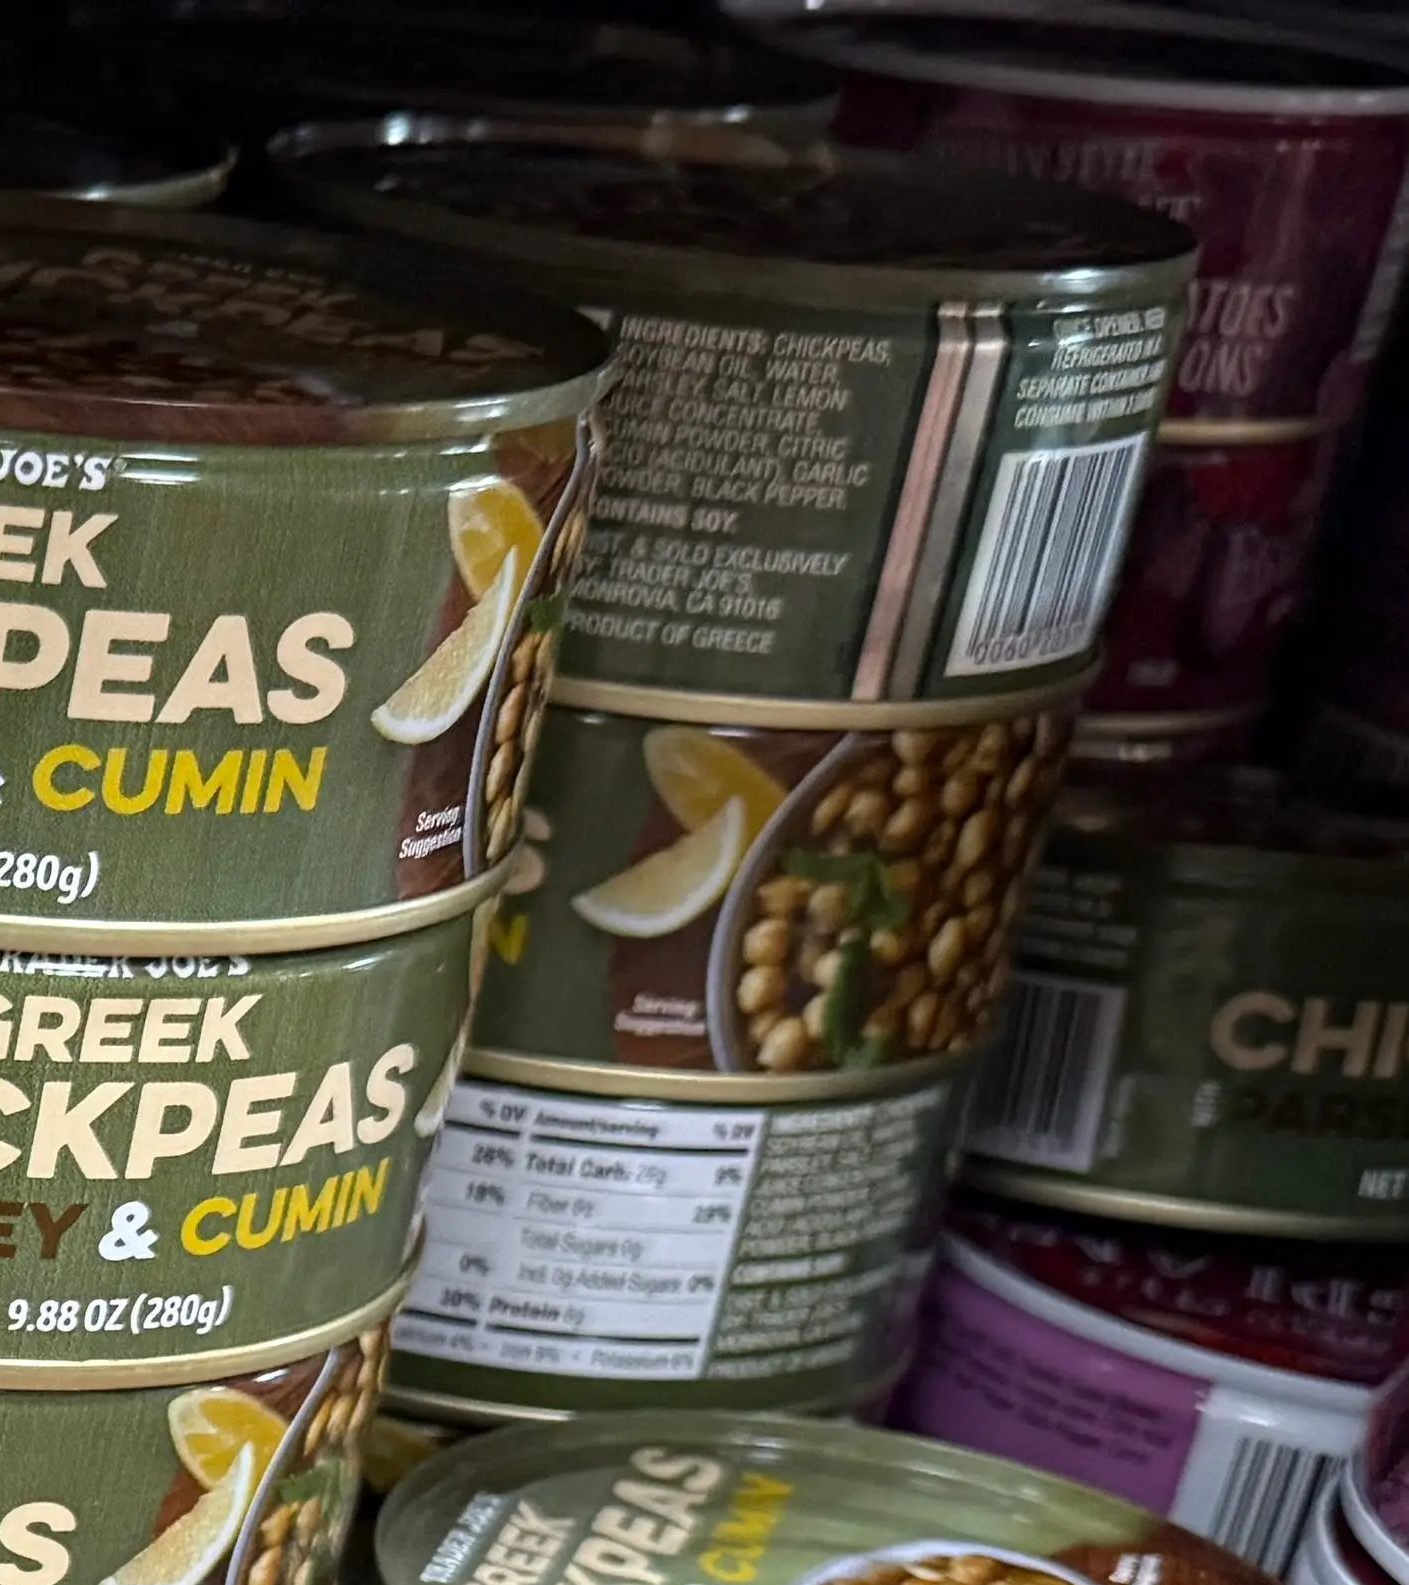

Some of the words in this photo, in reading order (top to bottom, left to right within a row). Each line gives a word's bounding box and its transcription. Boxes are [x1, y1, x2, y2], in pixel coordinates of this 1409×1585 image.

[32, 743, 327, 815] CUMIN
[98, 1201, 161, 1262] &
[181, 1156, 391, 1257] CUMIN
[7, 1298, 78, 1333] 9.88
[84, 1299, 124, 1333] OZ
[130, 1286, 234, 1336] (280g)
[698, 1472, 795, 1584] CUMIN
